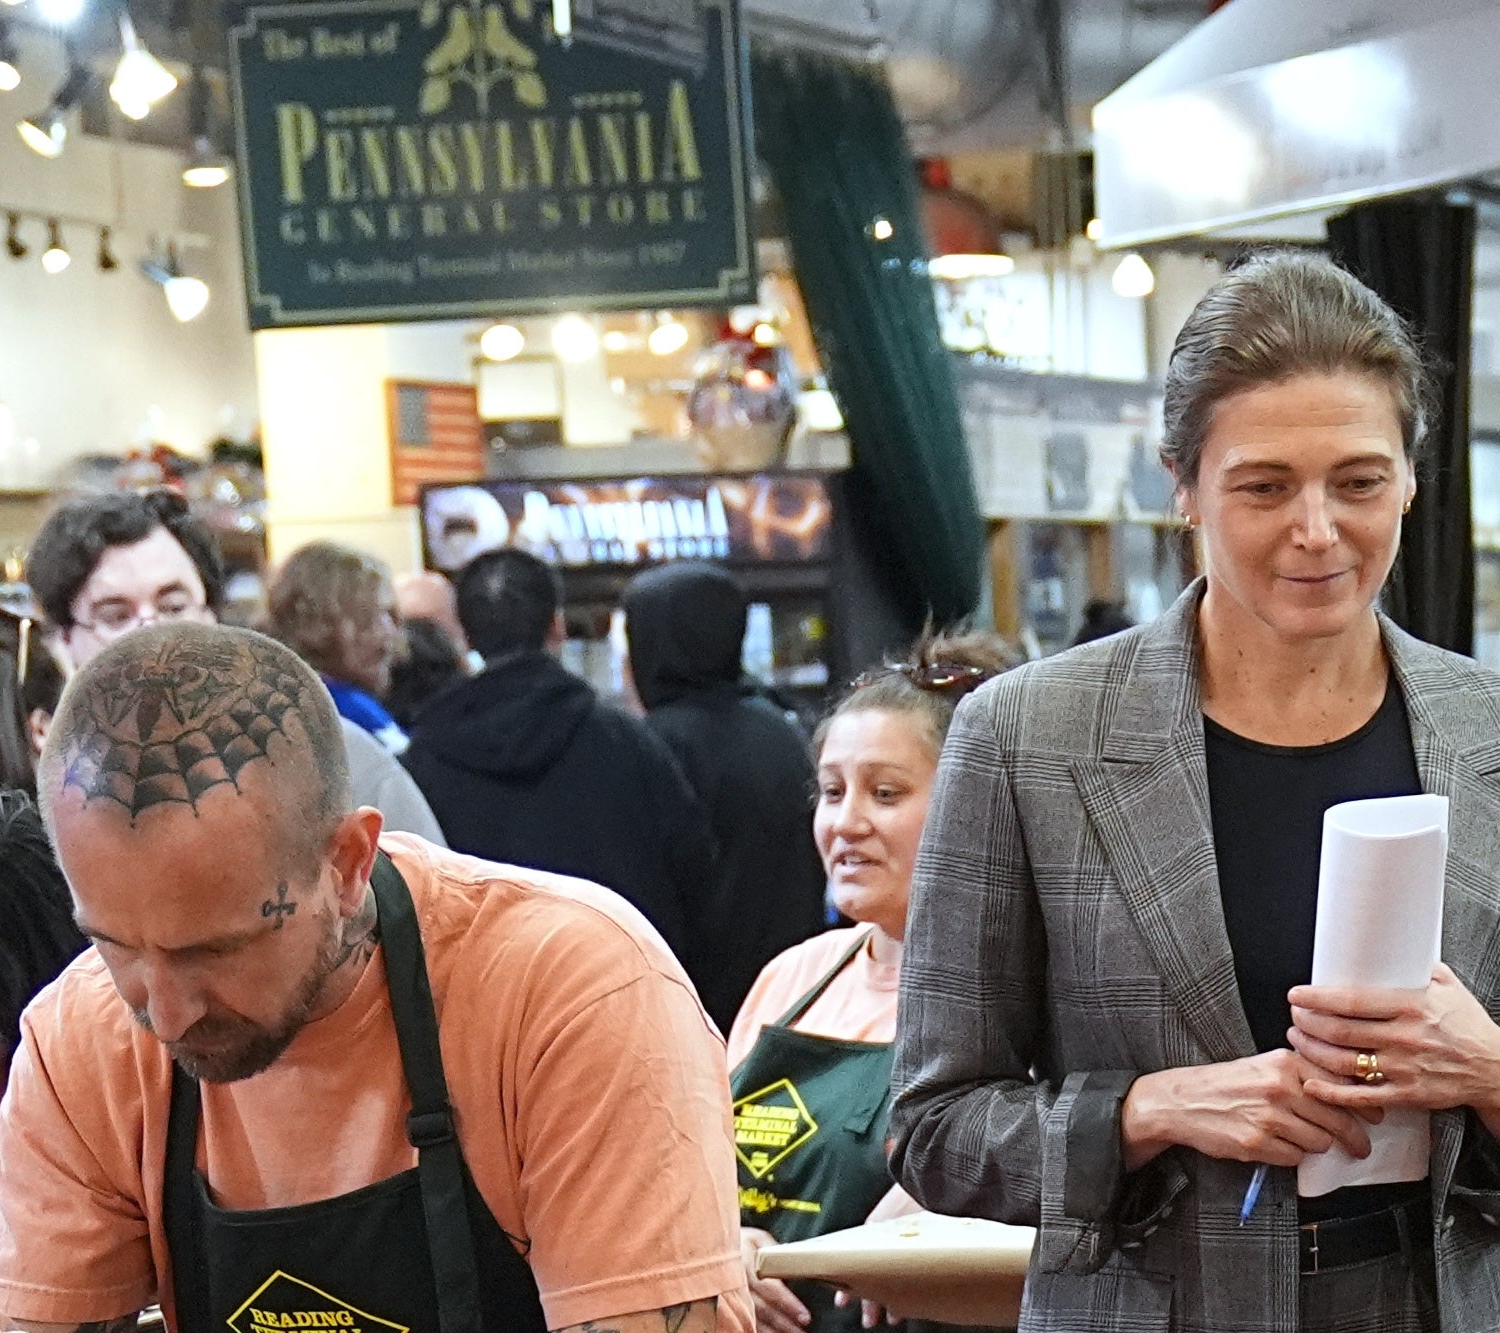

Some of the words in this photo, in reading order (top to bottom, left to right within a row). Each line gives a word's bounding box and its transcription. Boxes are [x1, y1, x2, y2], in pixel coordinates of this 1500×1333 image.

[262, 29, 304, 60] The
[313, 26, 364, 57] Best
[370, 22, 398, 53] of
[276, 79, 701, 203] PENNSYLVANIA
[280, 200, 508, 244] GENERAL
[538, 194, 705, 227] STORE
[249, 1307, 355, 1329] READING
